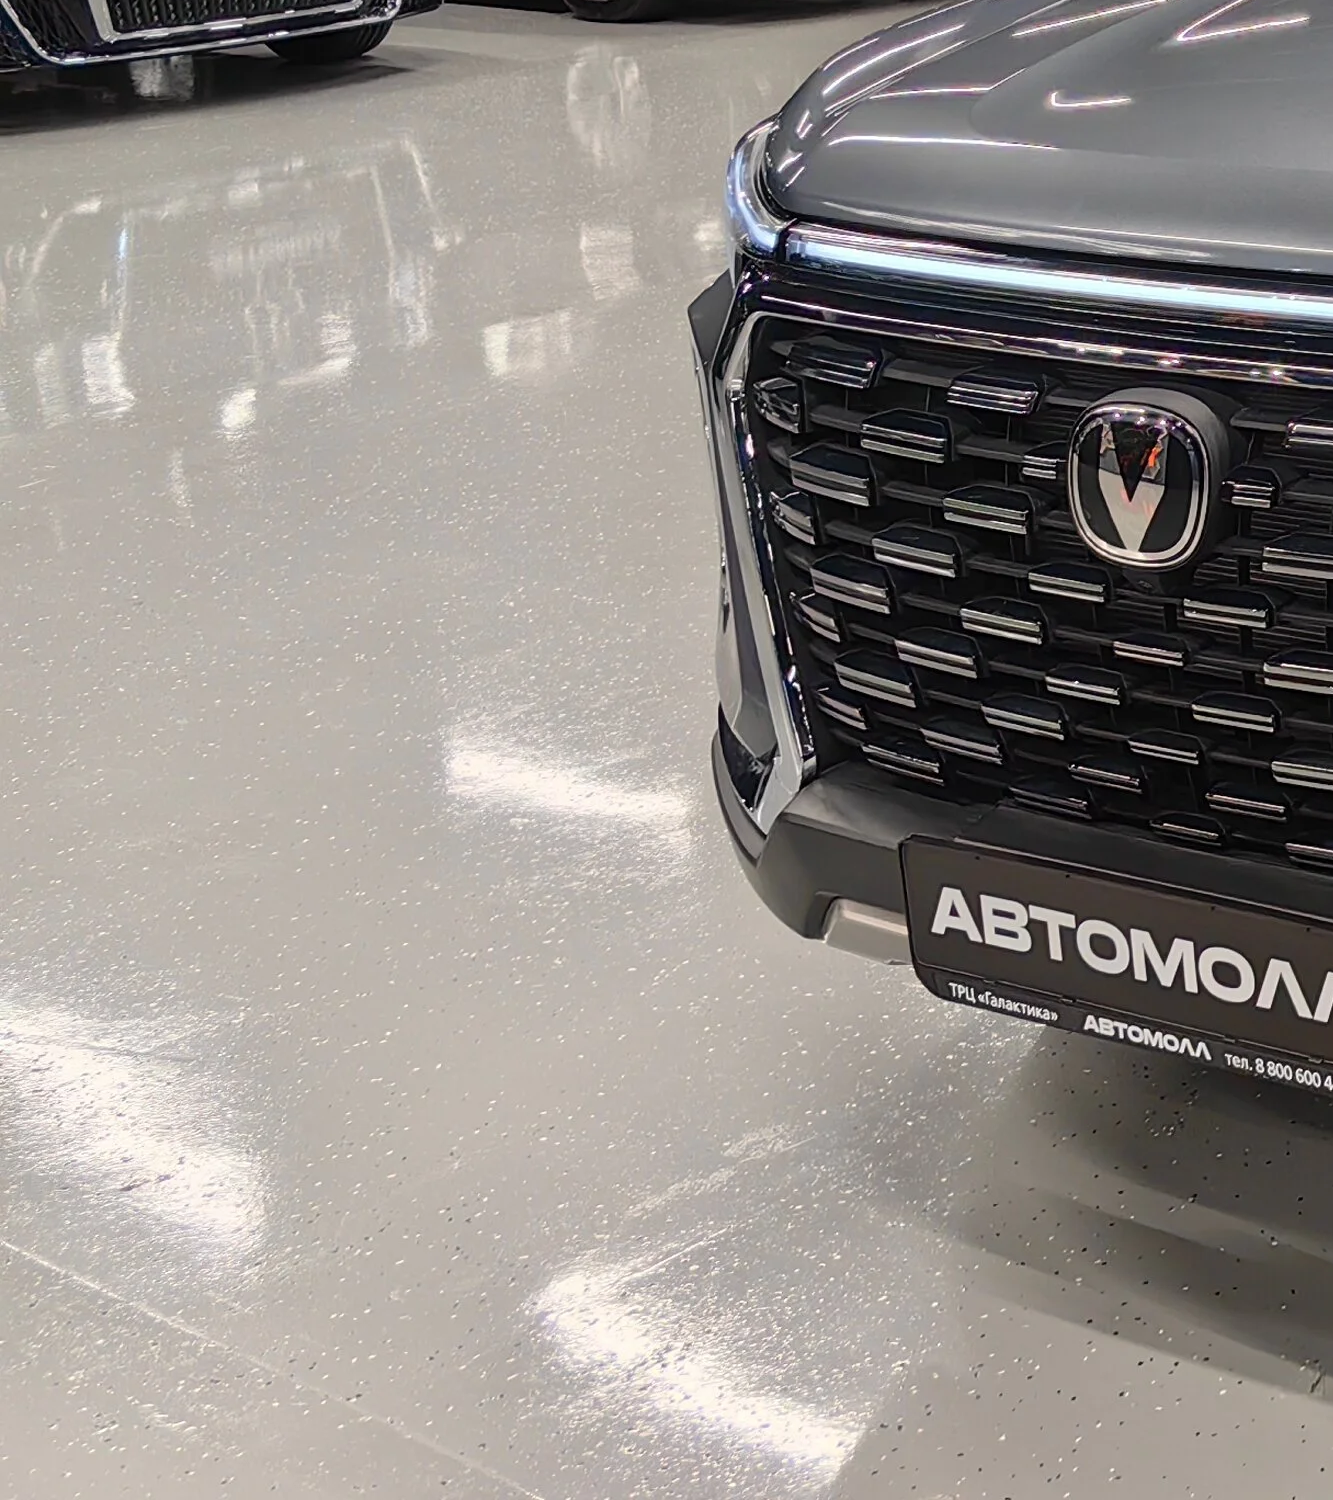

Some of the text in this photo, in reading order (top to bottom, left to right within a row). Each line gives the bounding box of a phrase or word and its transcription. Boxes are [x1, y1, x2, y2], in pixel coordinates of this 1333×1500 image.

[948, 982, 976, 1004] ТРЦ
[978, 991, 1059, 1021] «Галактика»
[1083, 1014, 1213, 1061] АВТОМОЛЛ
[1224, 1053, 1253, 1071] тел.
[1255, 1057, 1265, 1074] 8
[1266, 1061, 1293, 1081] 800
[1295, 1068, 1322, 1088] 600
